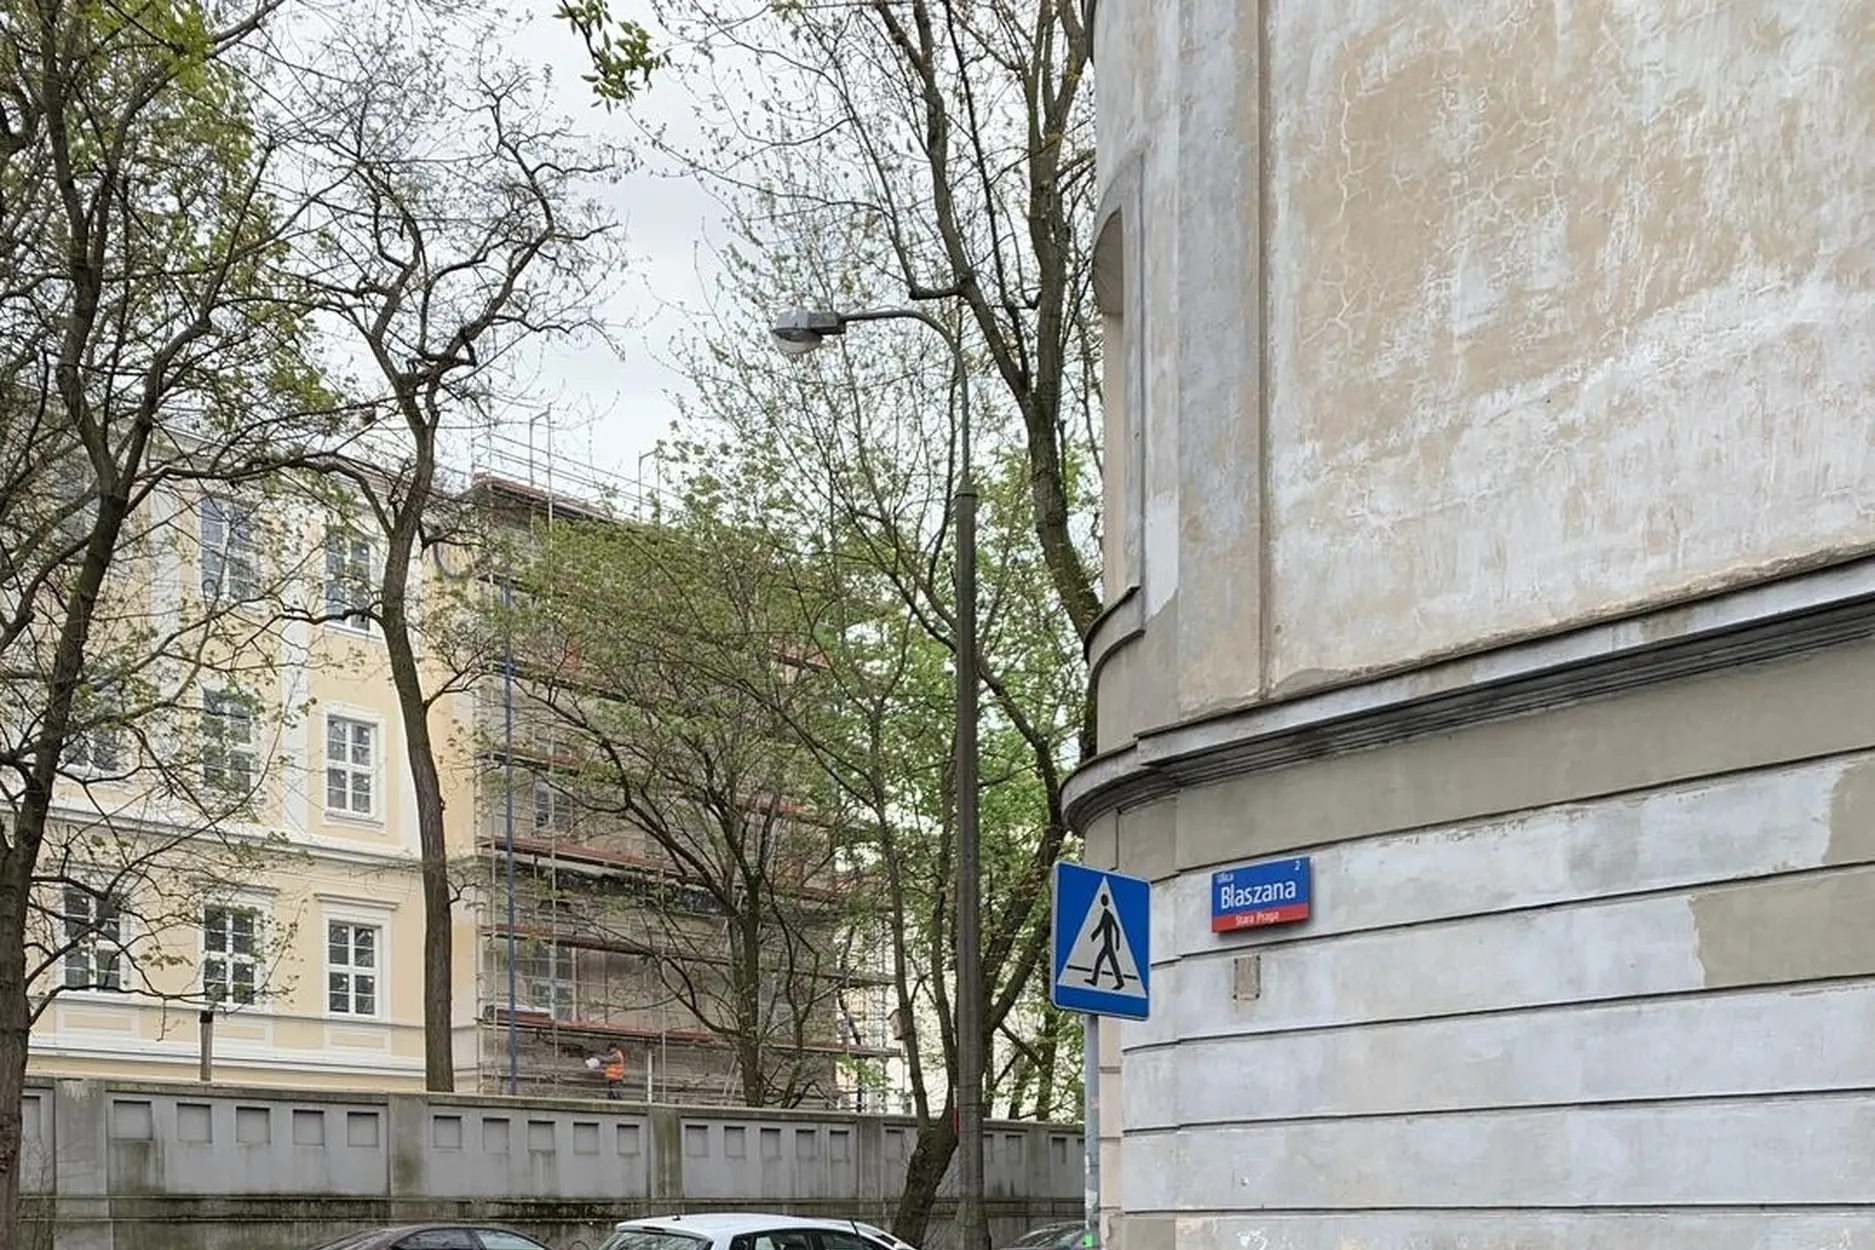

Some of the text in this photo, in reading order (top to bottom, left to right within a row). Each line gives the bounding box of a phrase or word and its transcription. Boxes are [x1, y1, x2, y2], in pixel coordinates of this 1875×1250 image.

[1294, 861, 1301, 871] 2
[1221, 880, 1296, 909] Blaszana
[1235, 911, 1279, 928] Stara Praga
